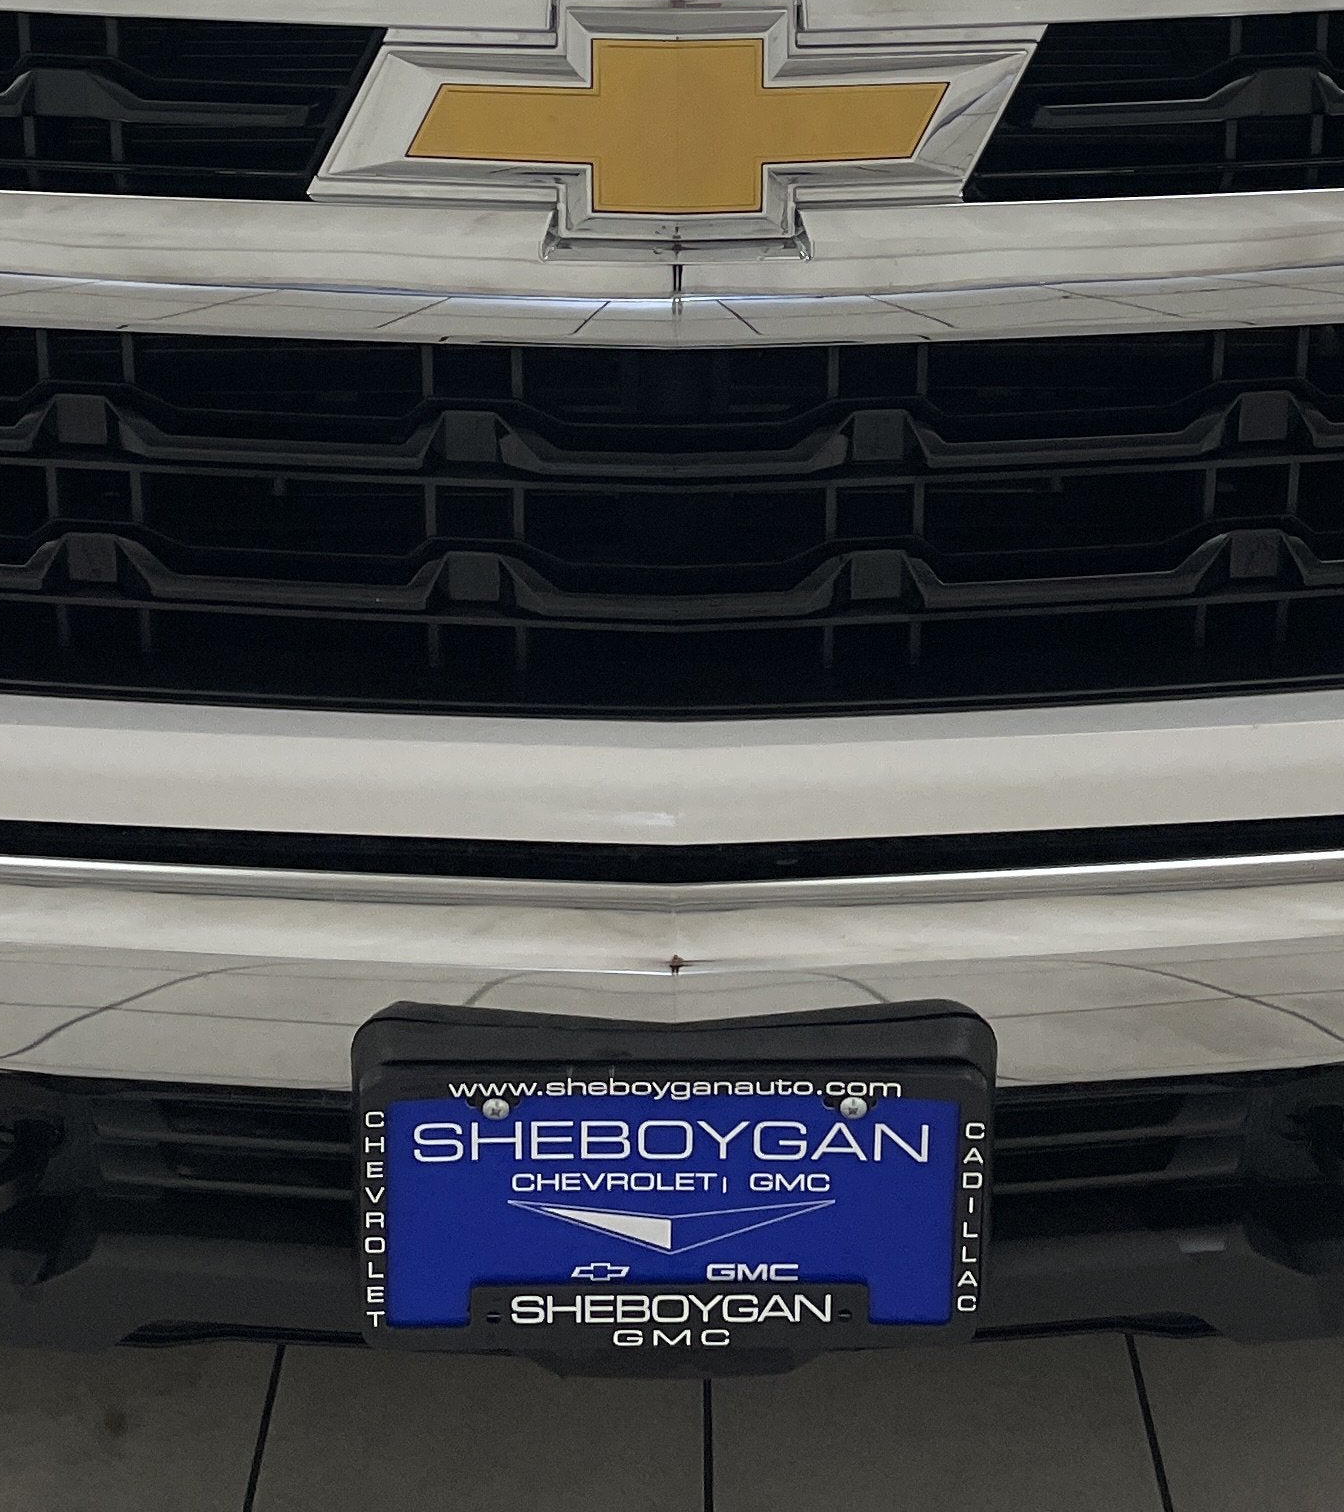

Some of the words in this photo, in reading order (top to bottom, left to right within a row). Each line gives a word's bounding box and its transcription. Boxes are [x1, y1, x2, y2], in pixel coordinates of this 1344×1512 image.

[448, 1077, 902, 1099] www.sheboyganauto.com
[413, 1120, 929, 1163] SHEBOYGAN
[511, 1172, 717, 1192] CHEVROLET
[749, 1173, 831, 1192] GMC
[364, 1111, 386, 1328] CHEVROLET
[957, 1122, 986, 1312] CADILLAC
[706, 1263, 799, 1281] GMC
[511, 1293, 832, 1324] SHEBOYGAN
[612, 1329, 730, 1347] GMC
